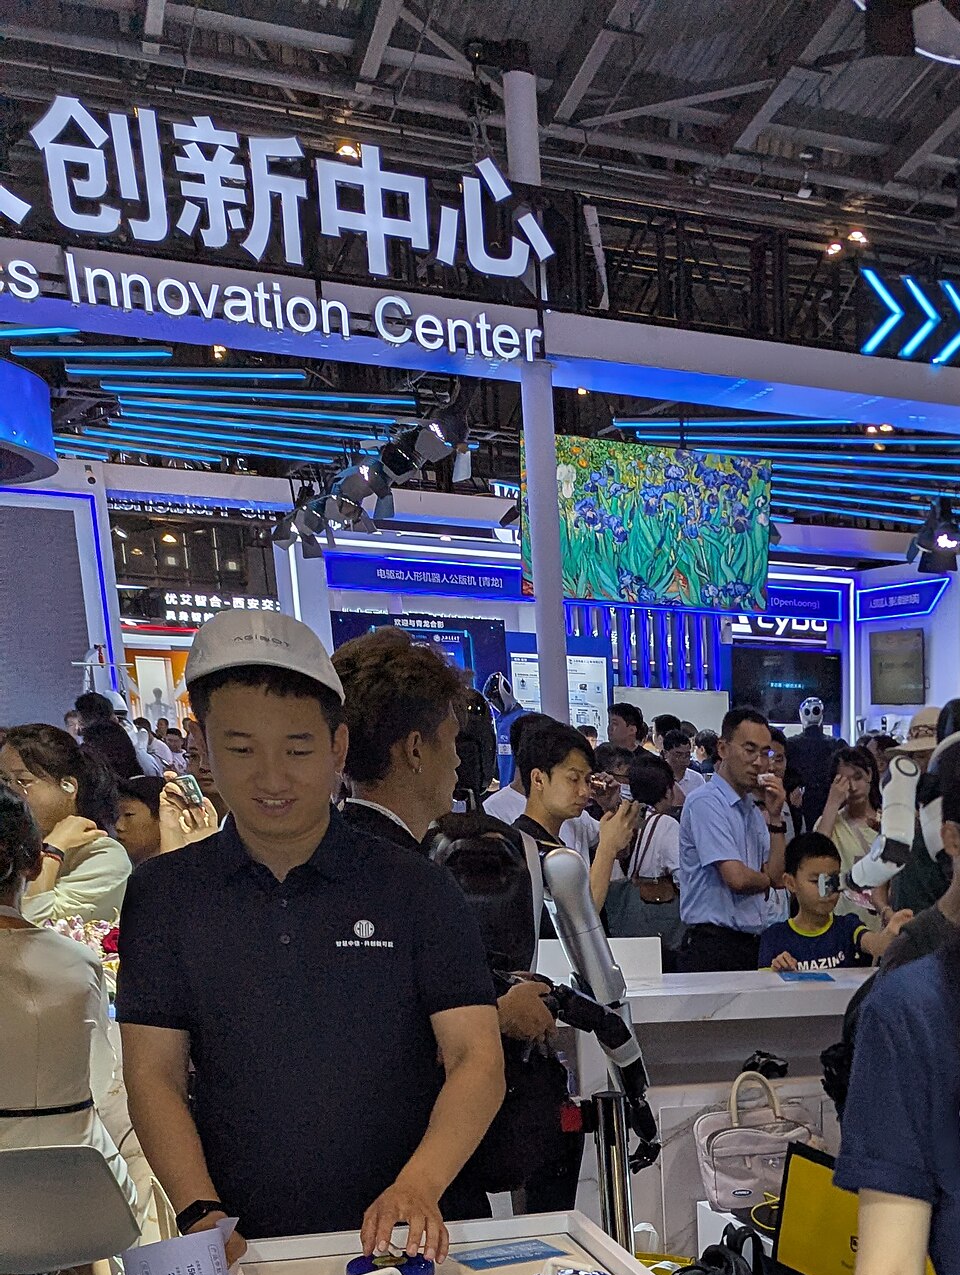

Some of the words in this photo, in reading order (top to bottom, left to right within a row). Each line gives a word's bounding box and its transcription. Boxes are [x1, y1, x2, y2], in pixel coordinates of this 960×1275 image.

[0, 95, 555, 276] 创新中心
[0, 260, 40, 300] s
[66, 252, 350, 336] Innovation
[375, 295, 543, 362] Center
[797, 950, 846, 971] MAZING
